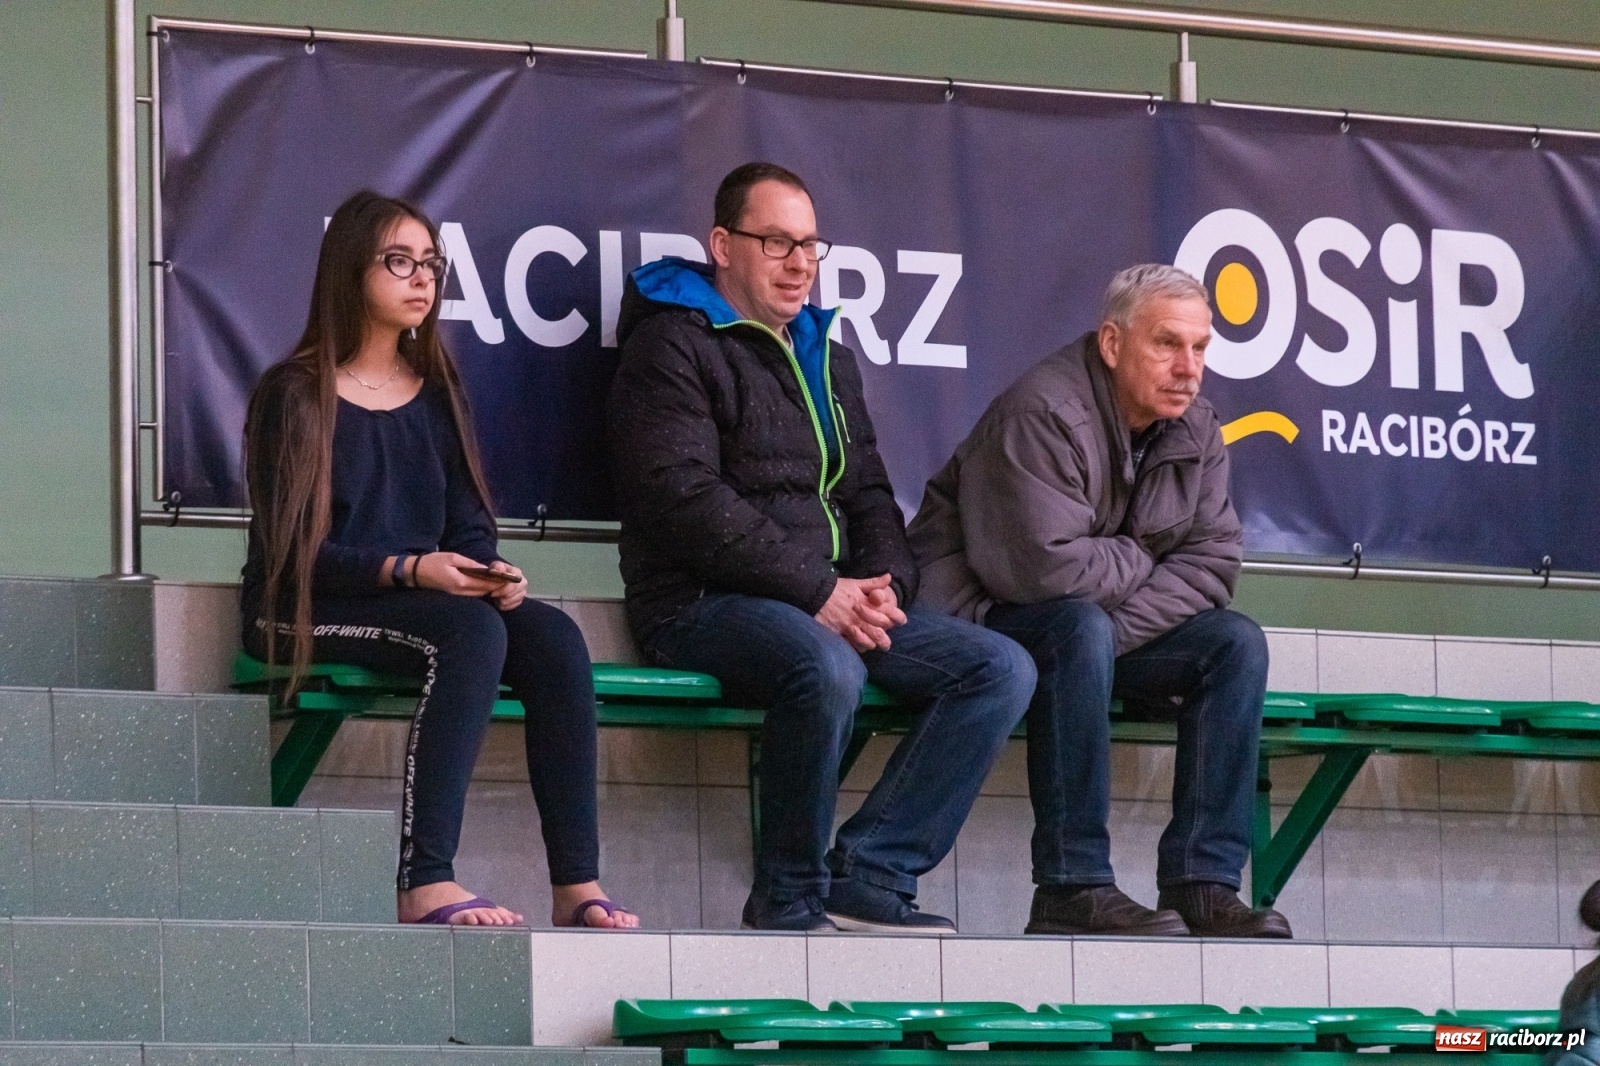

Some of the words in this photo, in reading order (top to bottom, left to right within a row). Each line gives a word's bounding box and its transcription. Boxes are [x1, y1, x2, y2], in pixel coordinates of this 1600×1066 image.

[1174, 208, 1535, 399] OSiR
[1321, 404, 1538, 466] RACIBÓRZ
[312, 624, 382, 640] OFF-WHITE
[403, 754, 416, 838] OFF-WHITE
